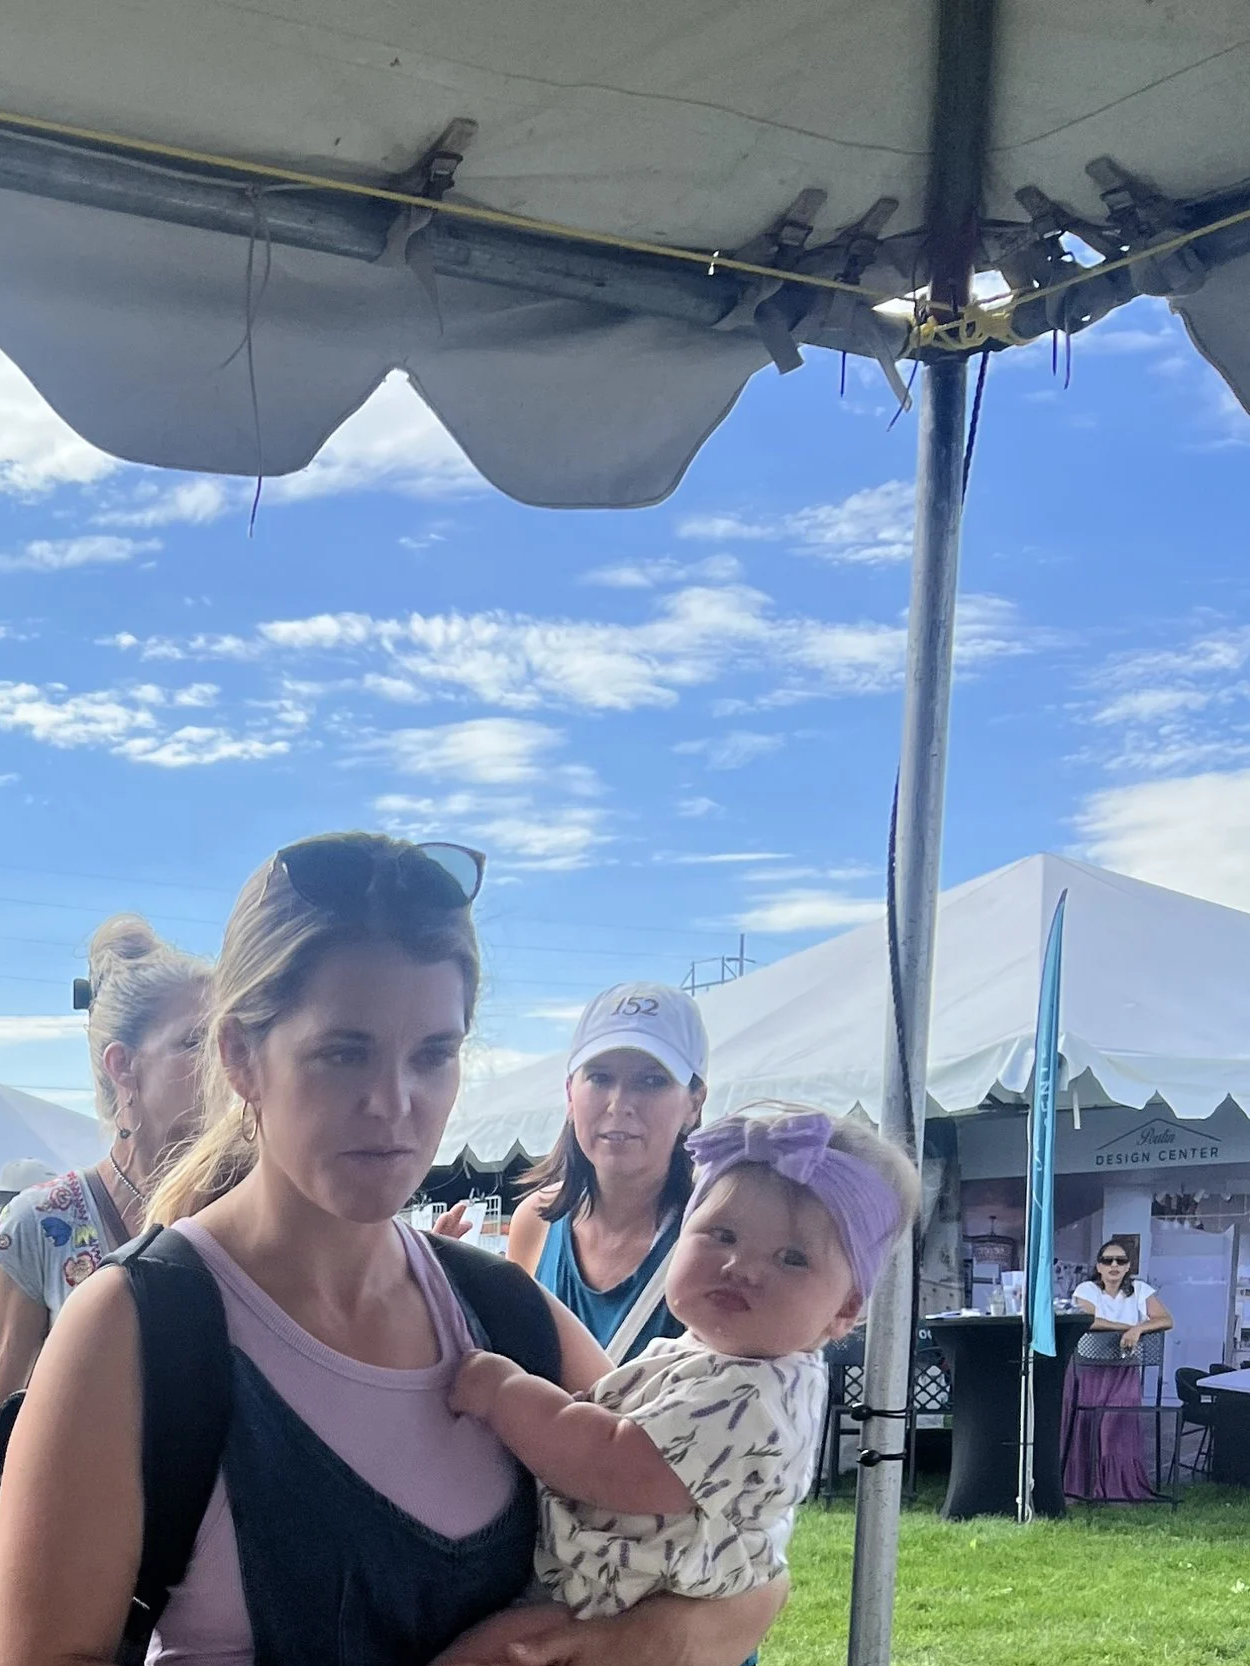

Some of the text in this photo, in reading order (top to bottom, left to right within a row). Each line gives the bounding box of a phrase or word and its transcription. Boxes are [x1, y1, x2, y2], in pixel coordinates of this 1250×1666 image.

[610, 996, 659, 1017] 152
[1095, 1147, 1220, 1166] DESIGN CENTER
